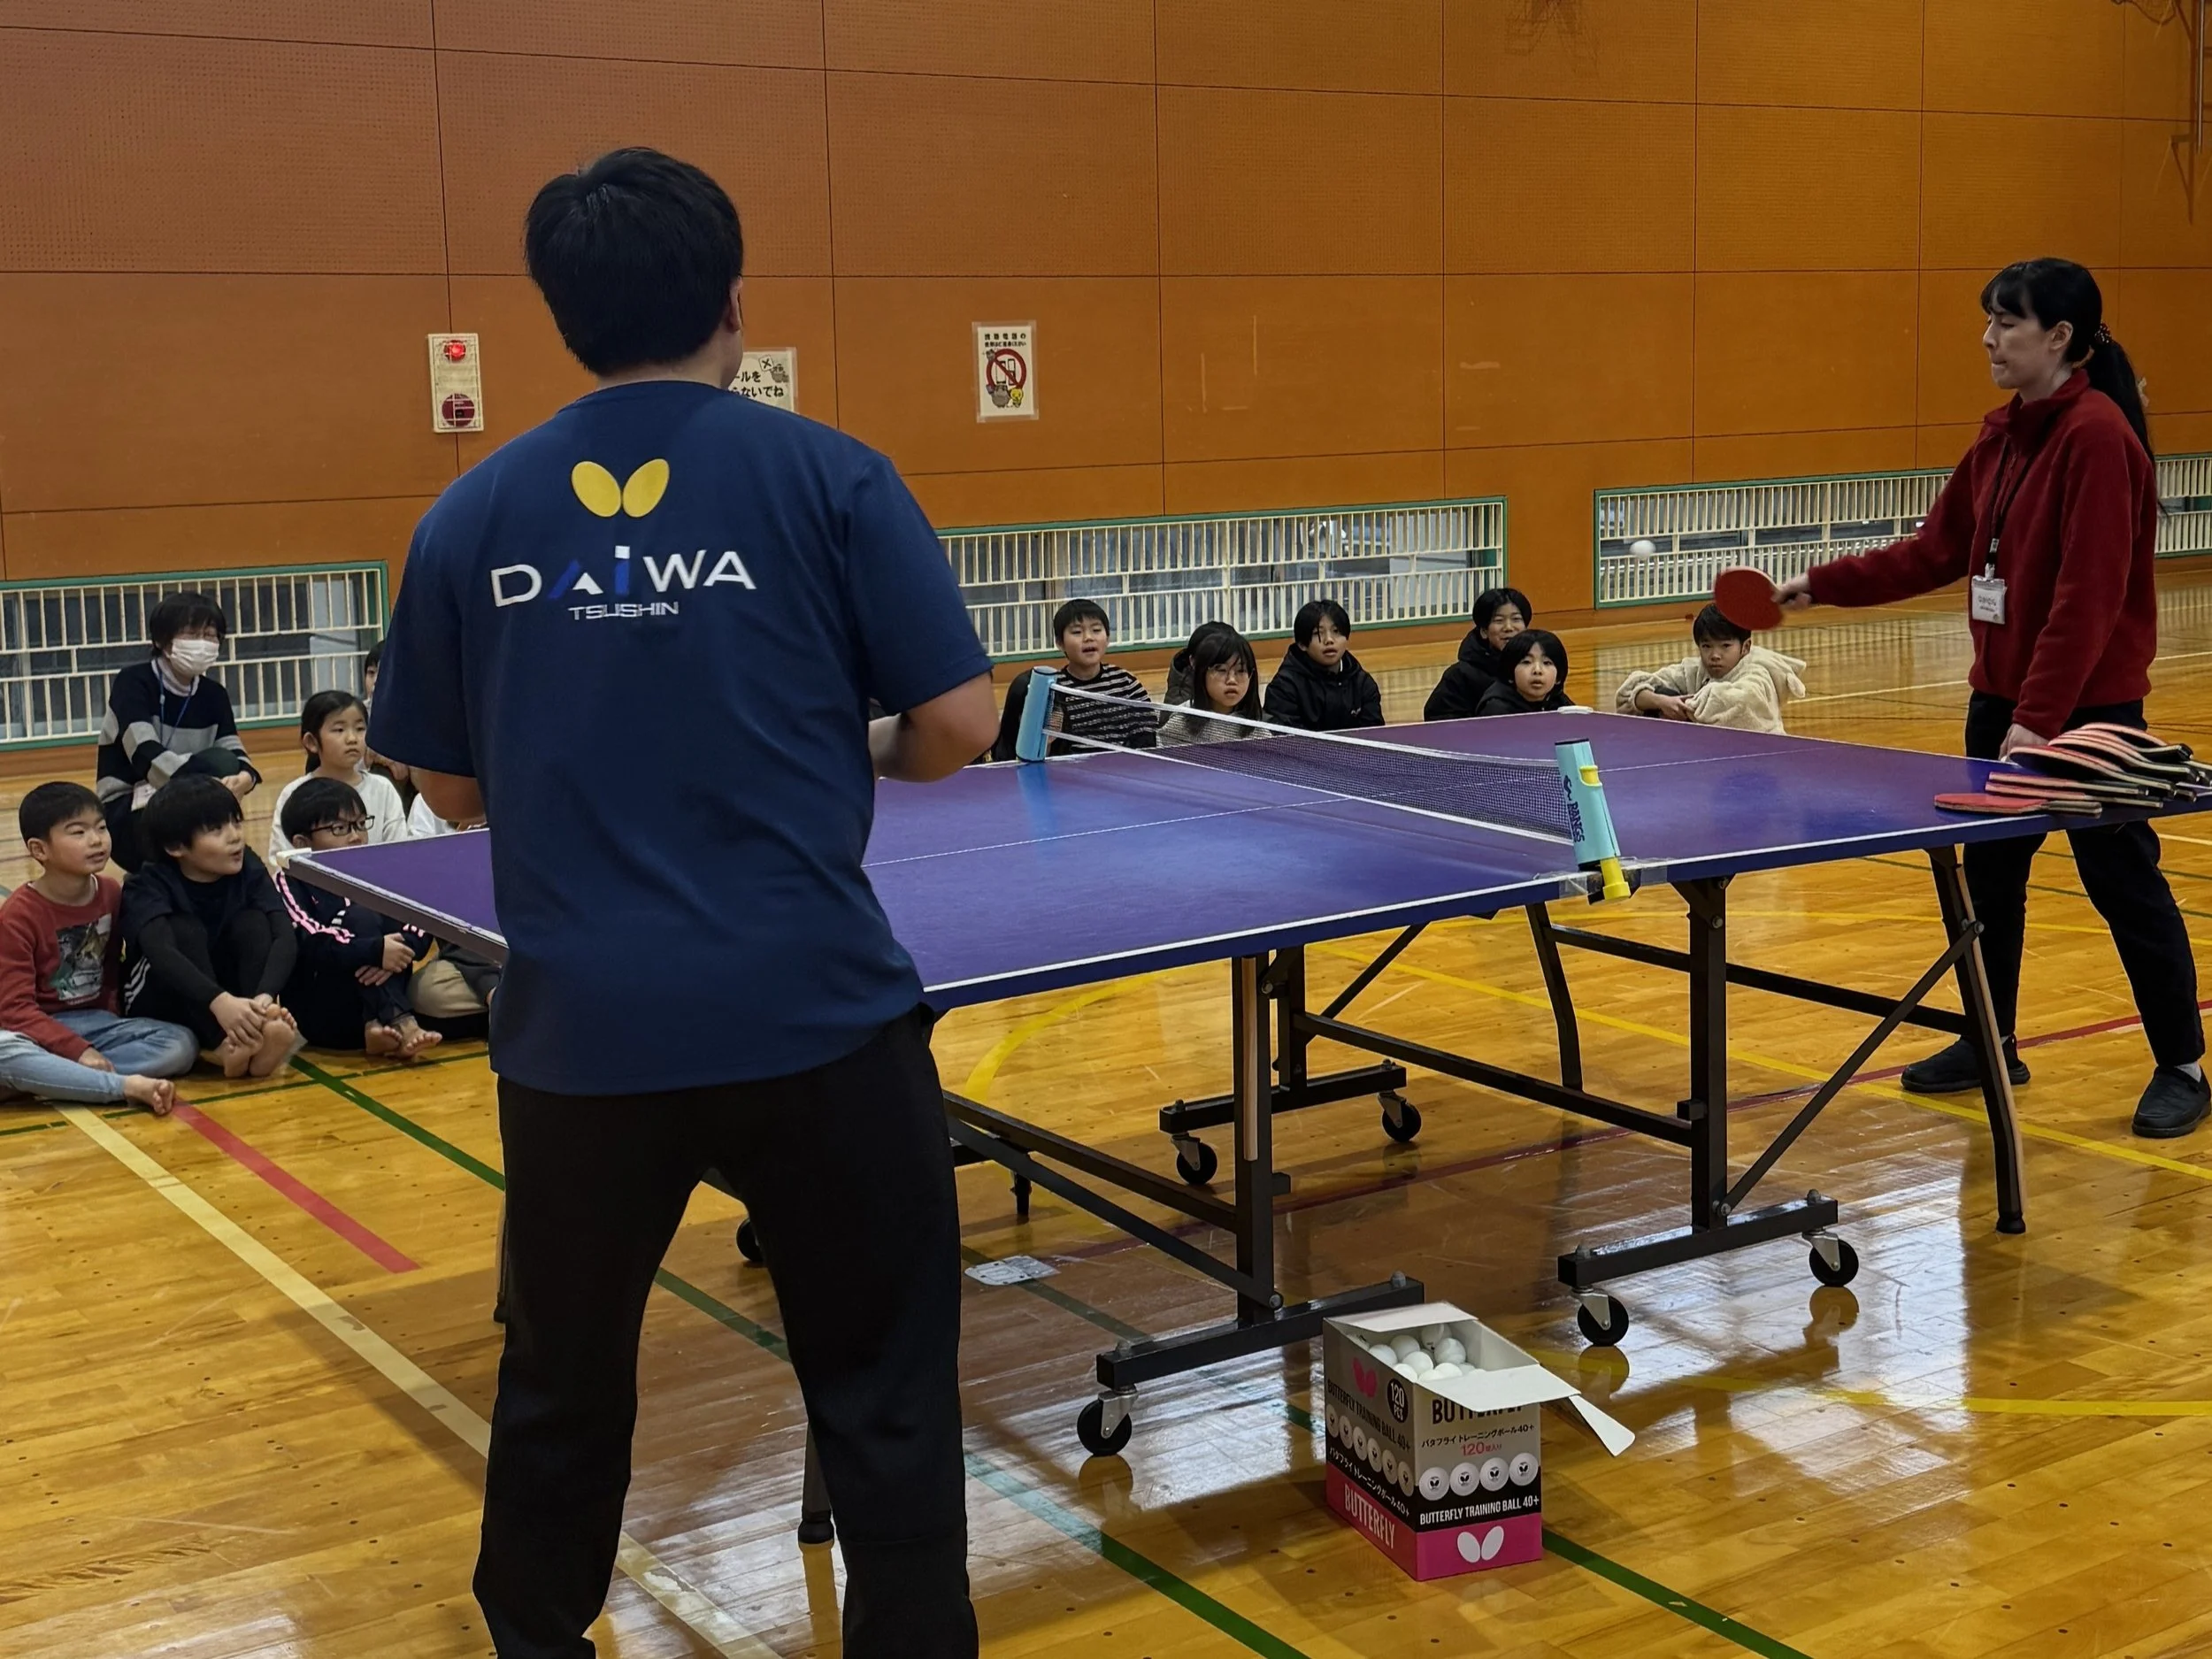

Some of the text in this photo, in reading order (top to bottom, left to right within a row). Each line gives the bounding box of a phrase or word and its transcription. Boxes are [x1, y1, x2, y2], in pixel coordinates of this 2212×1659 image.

[568, 601, 680, 621] TSUSHIN
[1390, 1382, 1405, 1409] 120
[1344, 1483, 1395, 1549] BUTTERFLY
[1420, 1494, 1540, 1525] BUTTERFLY TRAINING BALL 40+
